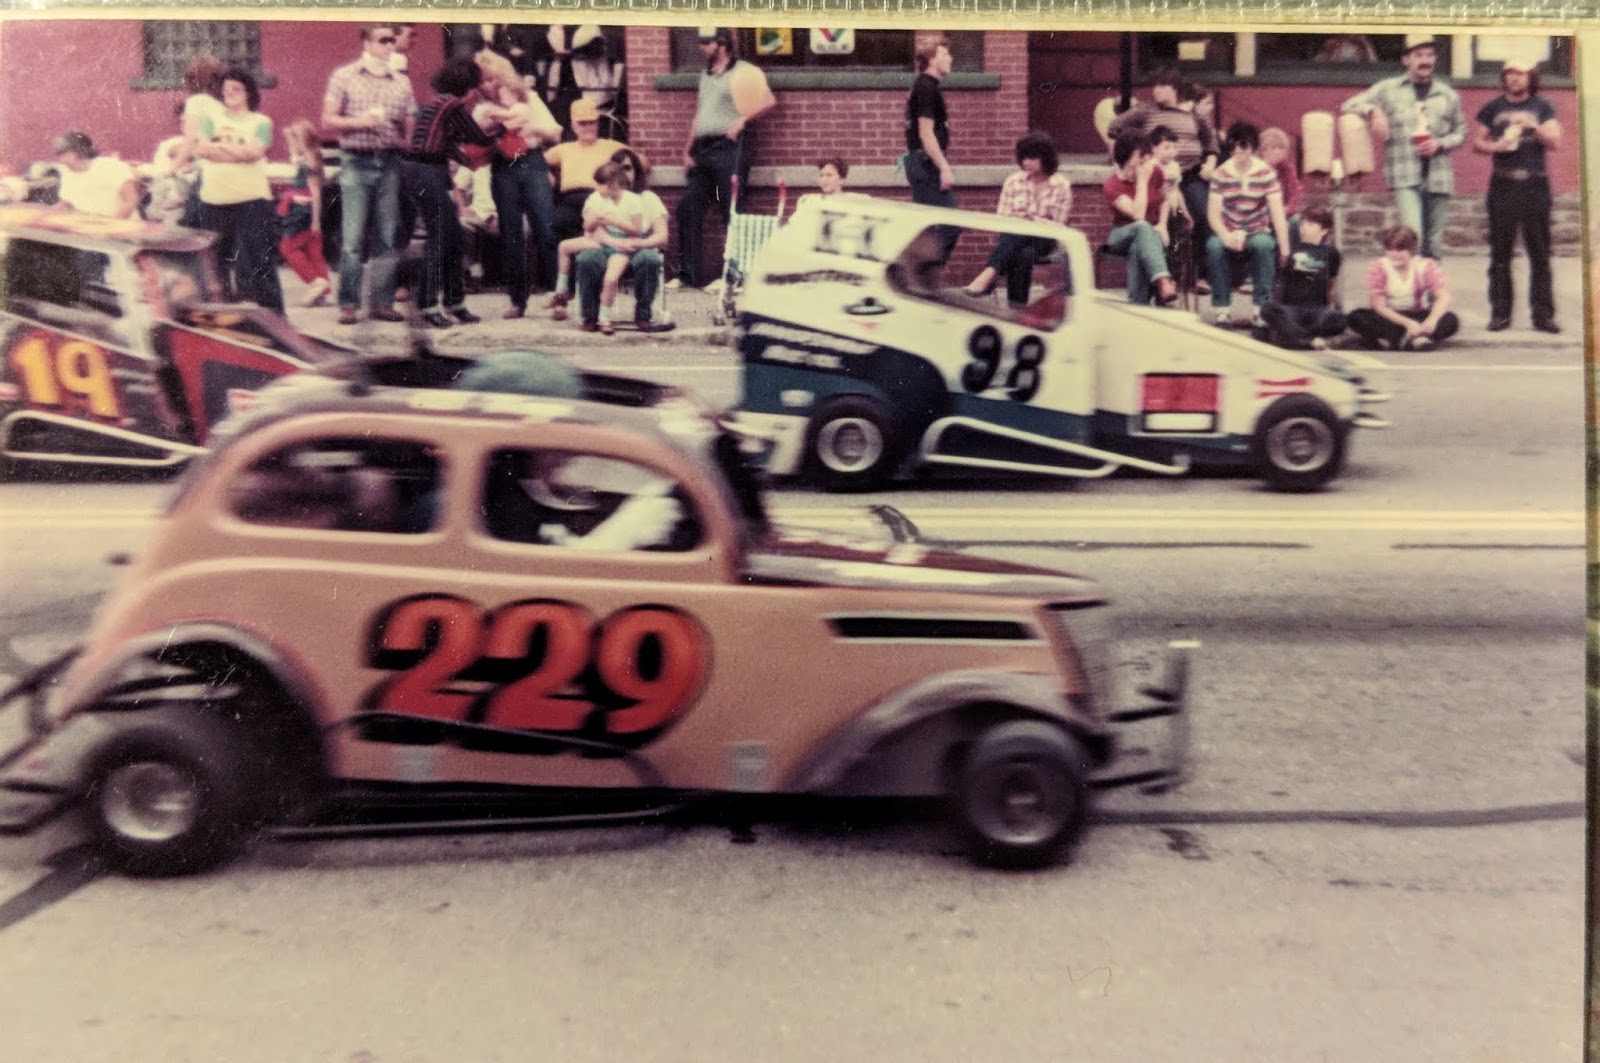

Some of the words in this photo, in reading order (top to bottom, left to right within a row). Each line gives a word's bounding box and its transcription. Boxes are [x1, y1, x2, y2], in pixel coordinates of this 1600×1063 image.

[11, 336, 121, 418] 19
[961, 325, 1046, 402] 98
[370, 593, 705, 740] 229
